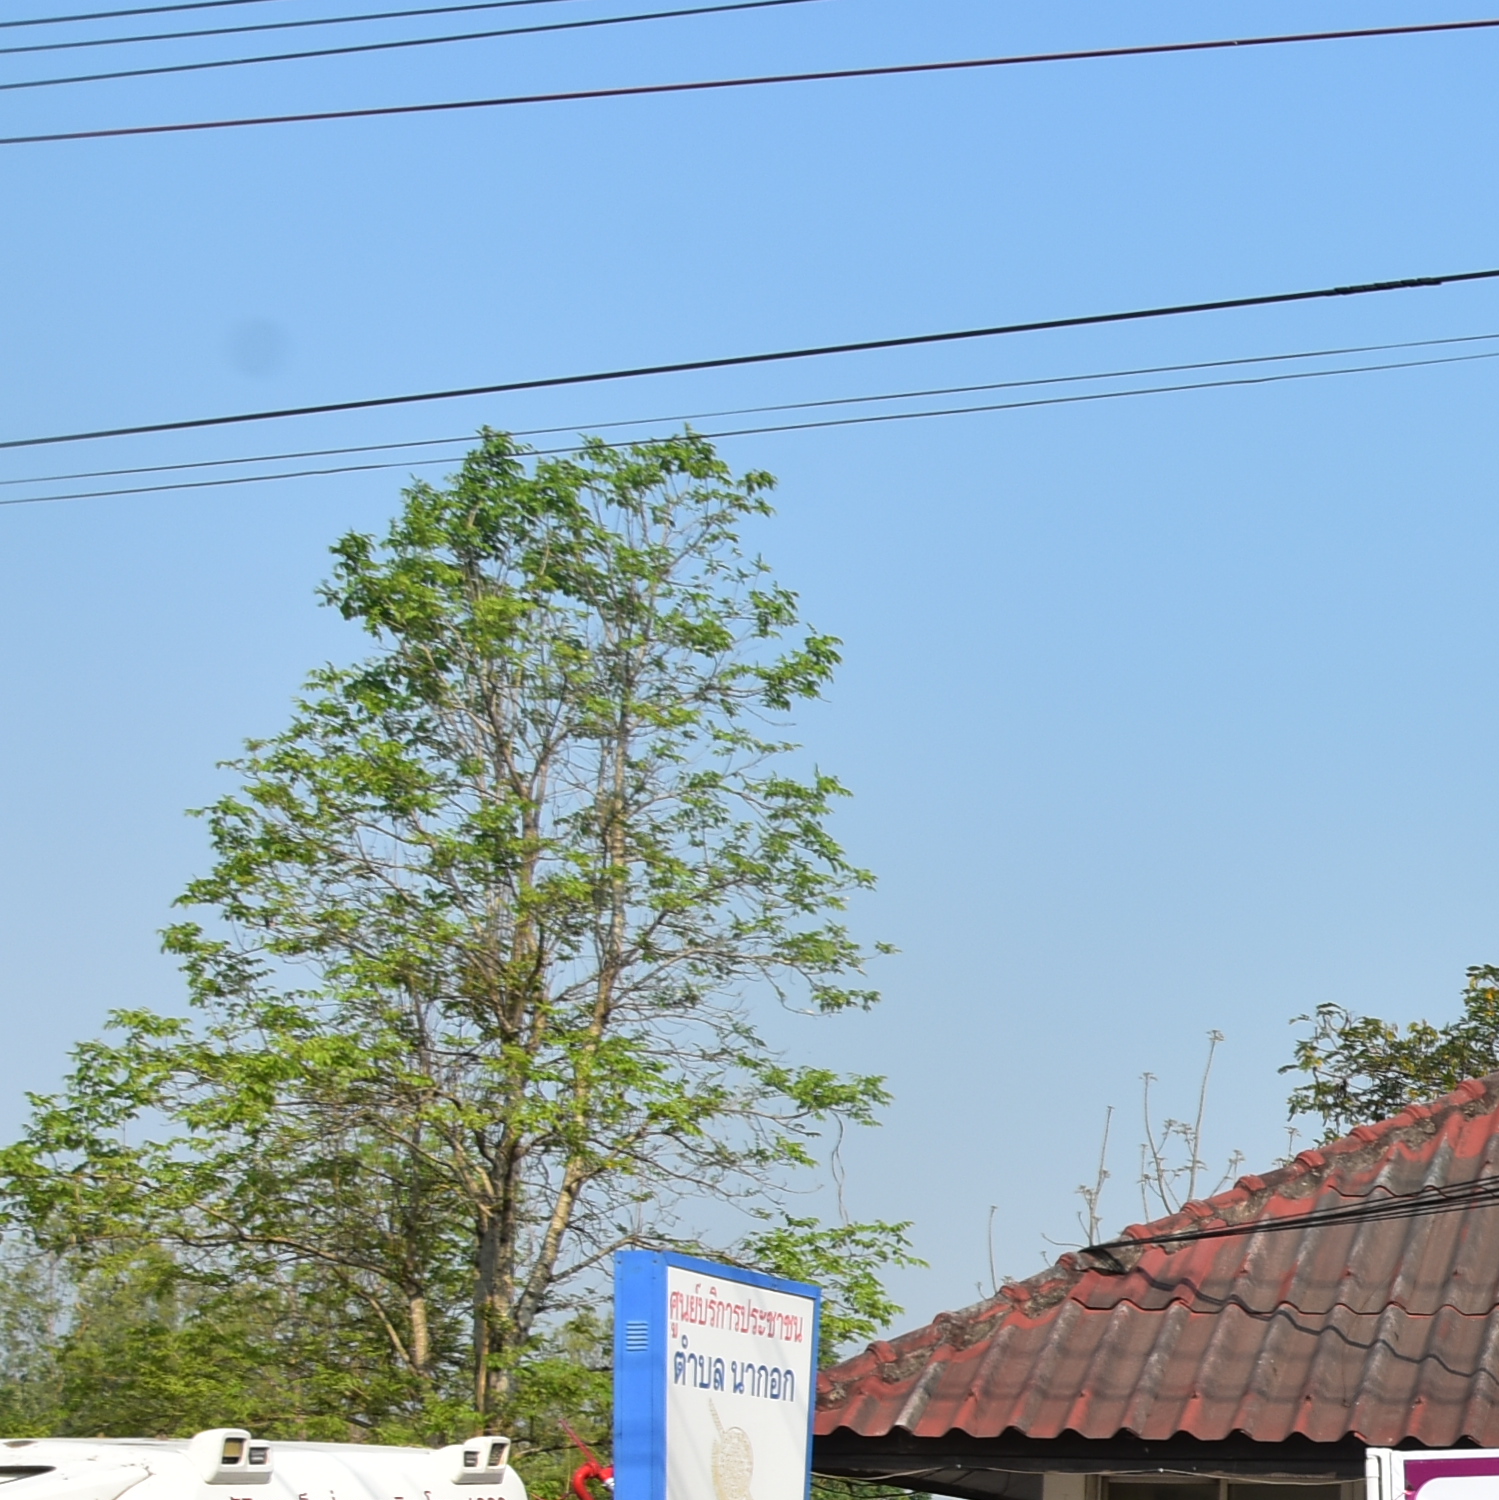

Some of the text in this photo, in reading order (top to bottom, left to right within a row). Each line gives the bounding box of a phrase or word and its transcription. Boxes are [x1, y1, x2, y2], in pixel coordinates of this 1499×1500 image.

[669, 1284, 804, 1343] ศูนย์บริการประชาชน
[674, 1334, 796, 1402] ตำบล นากอก
